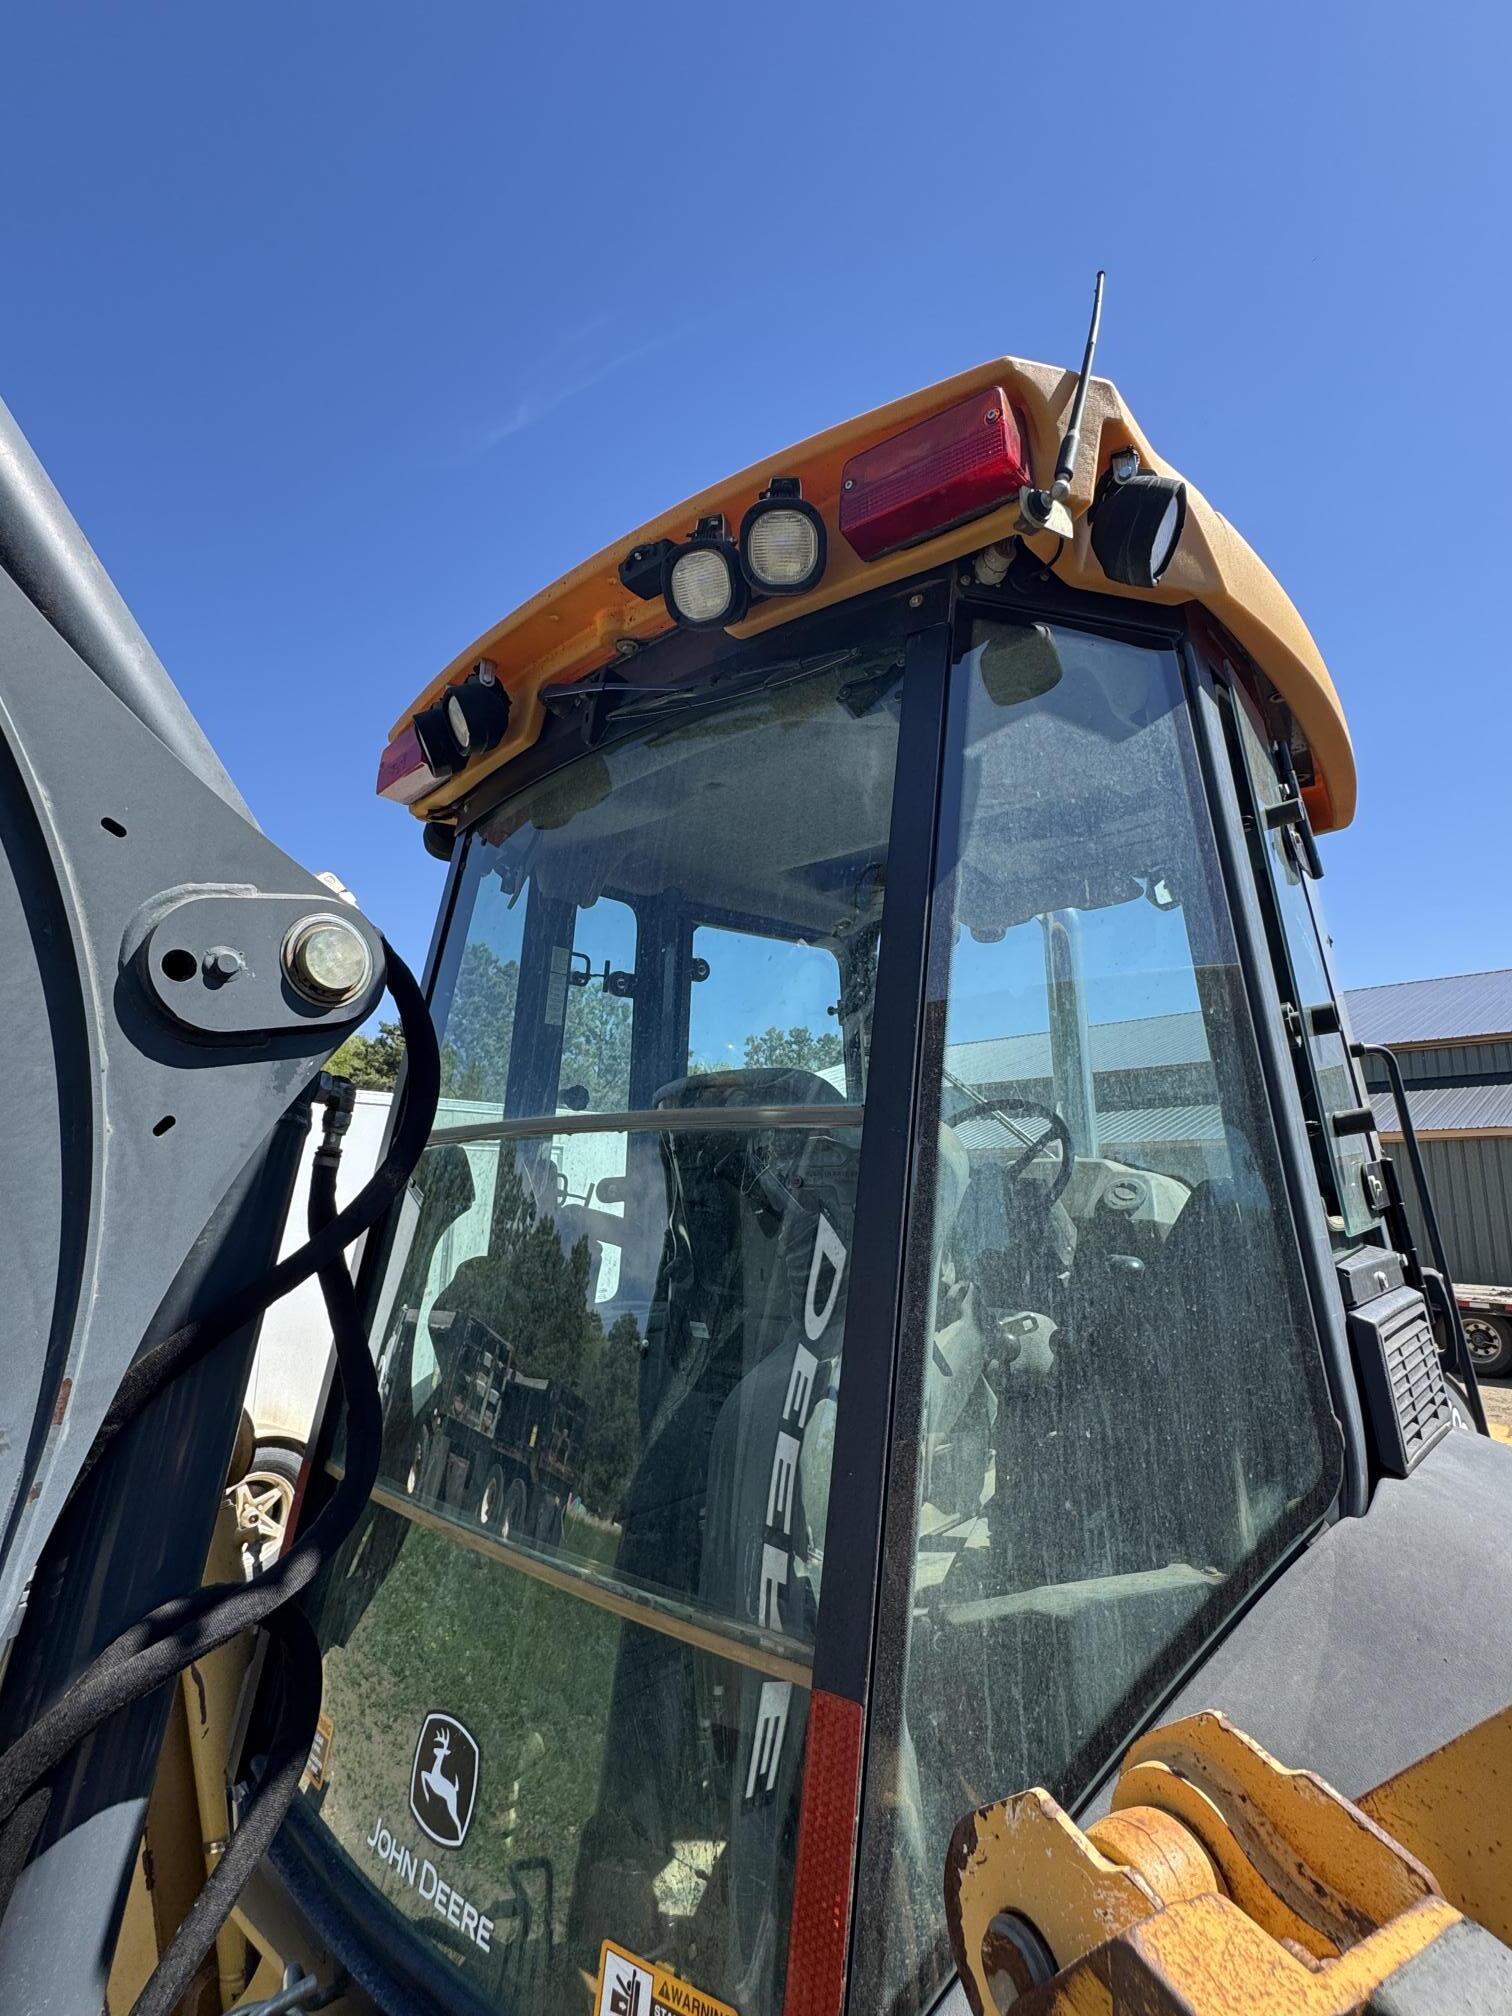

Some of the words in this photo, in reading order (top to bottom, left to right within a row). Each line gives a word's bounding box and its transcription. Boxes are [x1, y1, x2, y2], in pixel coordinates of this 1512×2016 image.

[367, 1817, 418, 1886] JOHN
[419, 1859, 495, 1954] DEERE
[671, 1984, 730, 2016] WARNI
